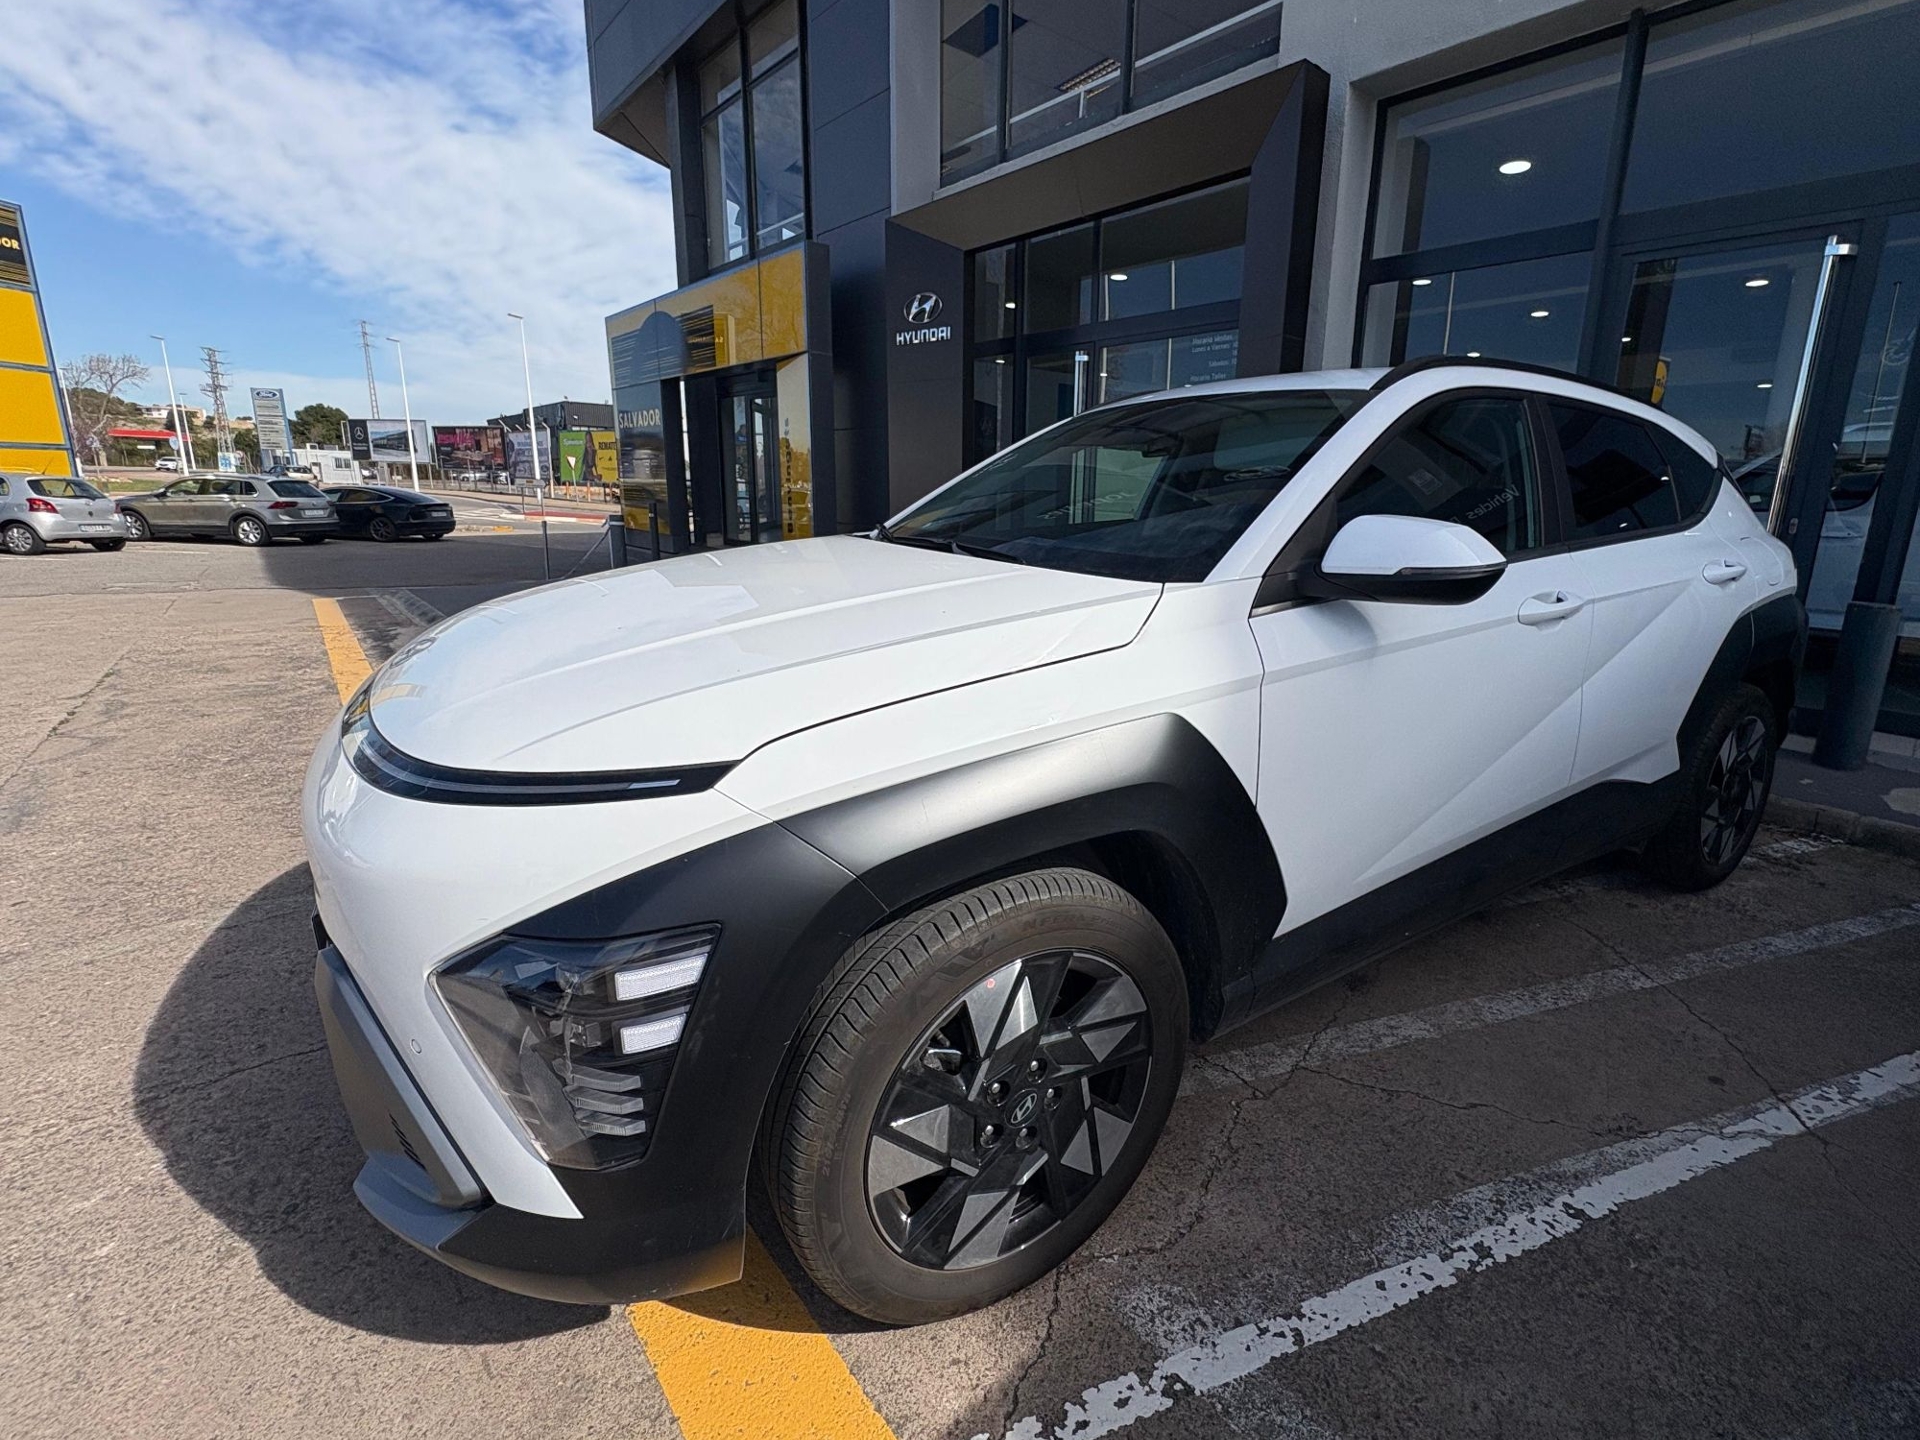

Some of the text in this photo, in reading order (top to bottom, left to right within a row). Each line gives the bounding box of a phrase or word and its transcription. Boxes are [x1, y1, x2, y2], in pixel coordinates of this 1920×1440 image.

[0, 236, 20, 250] OR
[896, 326, 951, 346] HYUNDAI
[618, 408, 661, 429] SALVADOR
